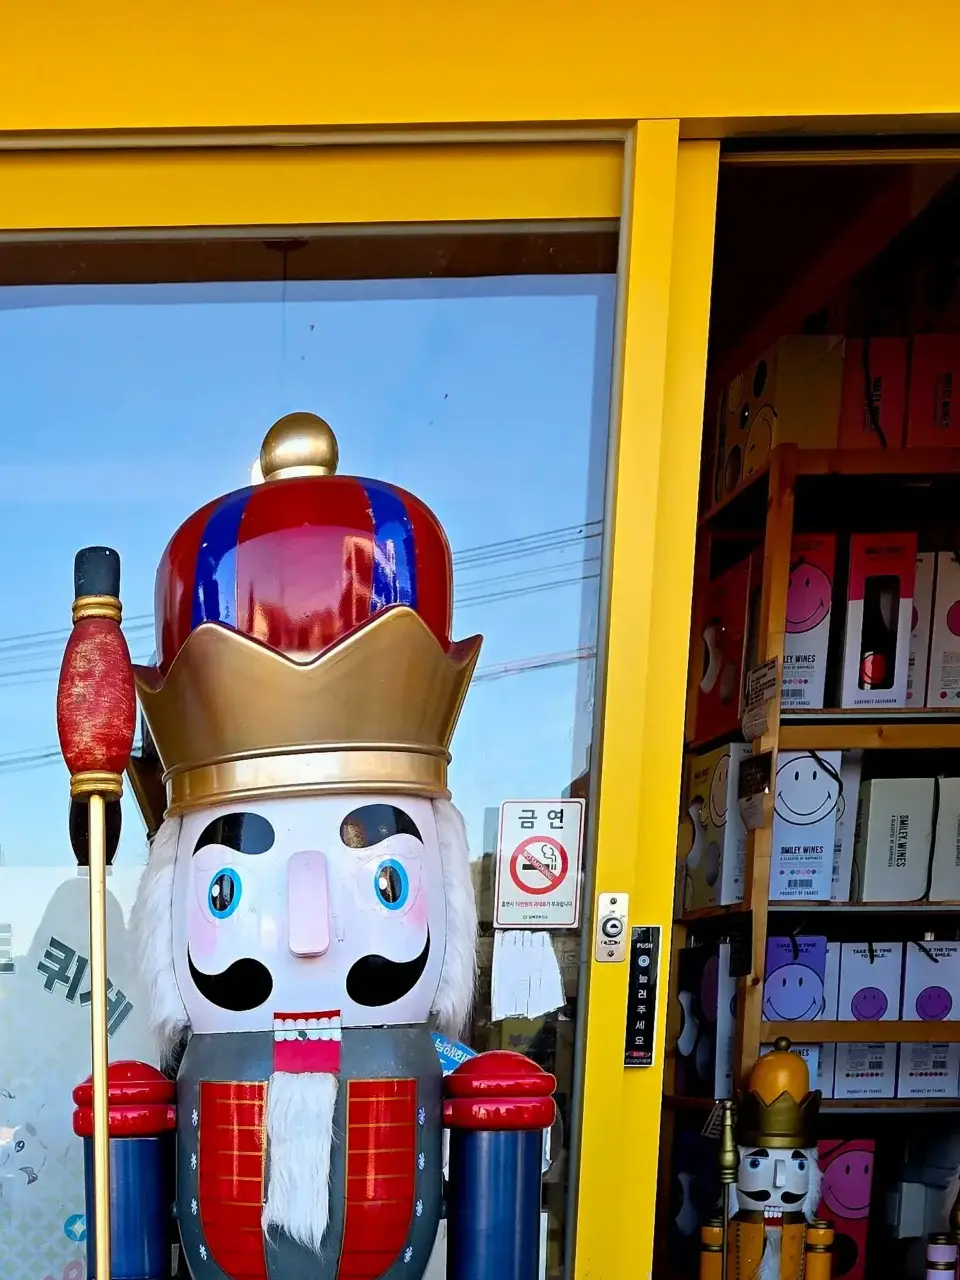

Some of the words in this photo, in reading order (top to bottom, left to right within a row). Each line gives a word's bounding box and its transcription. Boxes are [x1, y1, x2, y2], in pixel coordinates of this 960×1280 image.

[796, 655, 815, 663] WINES
[899, 814, 909, 842] SMILEY
[780, 846, 801, 854] SMILEY
[803, 845, 824, 853] WINES
[896, 843, 907, 868] WINES
